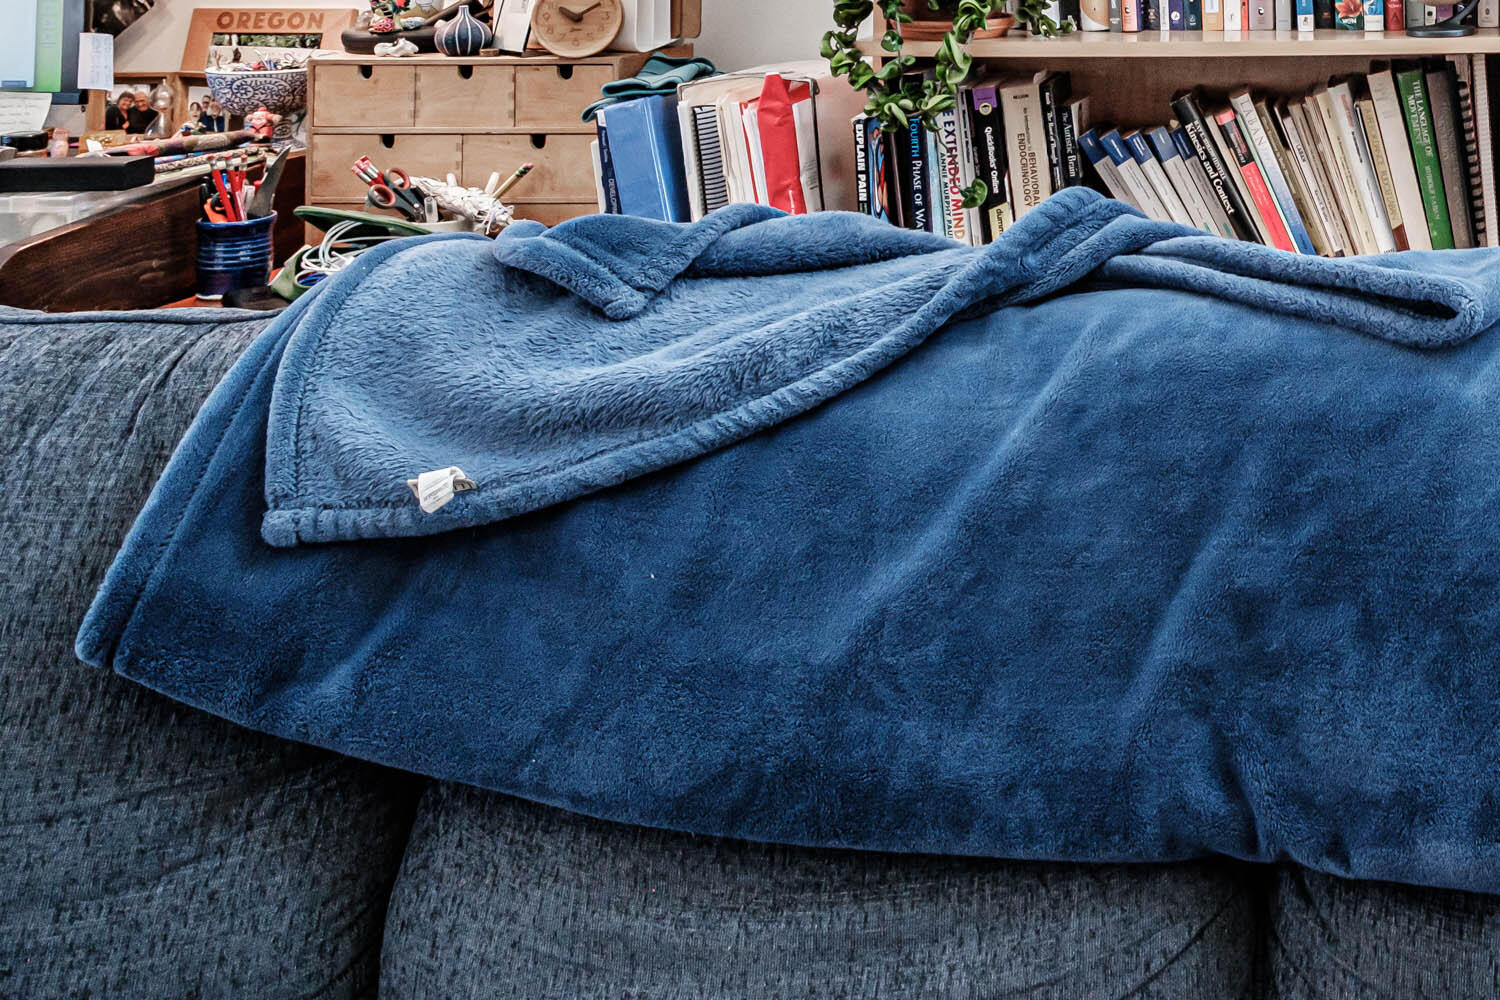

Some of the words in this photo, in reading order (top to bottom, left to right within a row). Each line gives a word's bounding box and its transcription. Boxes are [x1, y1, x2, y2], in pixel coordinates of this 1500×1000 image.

[216, 12, 324, 30] OREGON
[856, 123, 866, 170] EXPLAIN
[909, 117, 920, 157] FOURTH
[985, 126, 998, 167] QuickBooks
[912, 159, 923, 190] PHASE
[940, 151, 948, 178] ANNIE
[943, 121, 960, 195] EXTENDED
[1017, 132, 1032, 207] ENDOCRINOLOGY
[1185, 122, 1209, 160] Kinesics
[1203, 160, 1217, 177] and
[1212, 178, 1235, 214] Context
[857, 173, 867, 200] PAIN
[915, 192, 923, 205] OF
[942, 181, 951, 216] MURPHY
[991, 170, 1000, 193] Online
[1028, 151, 1040, 206] BEHAVIORAL
[951, 199, 965, 239] MIND
